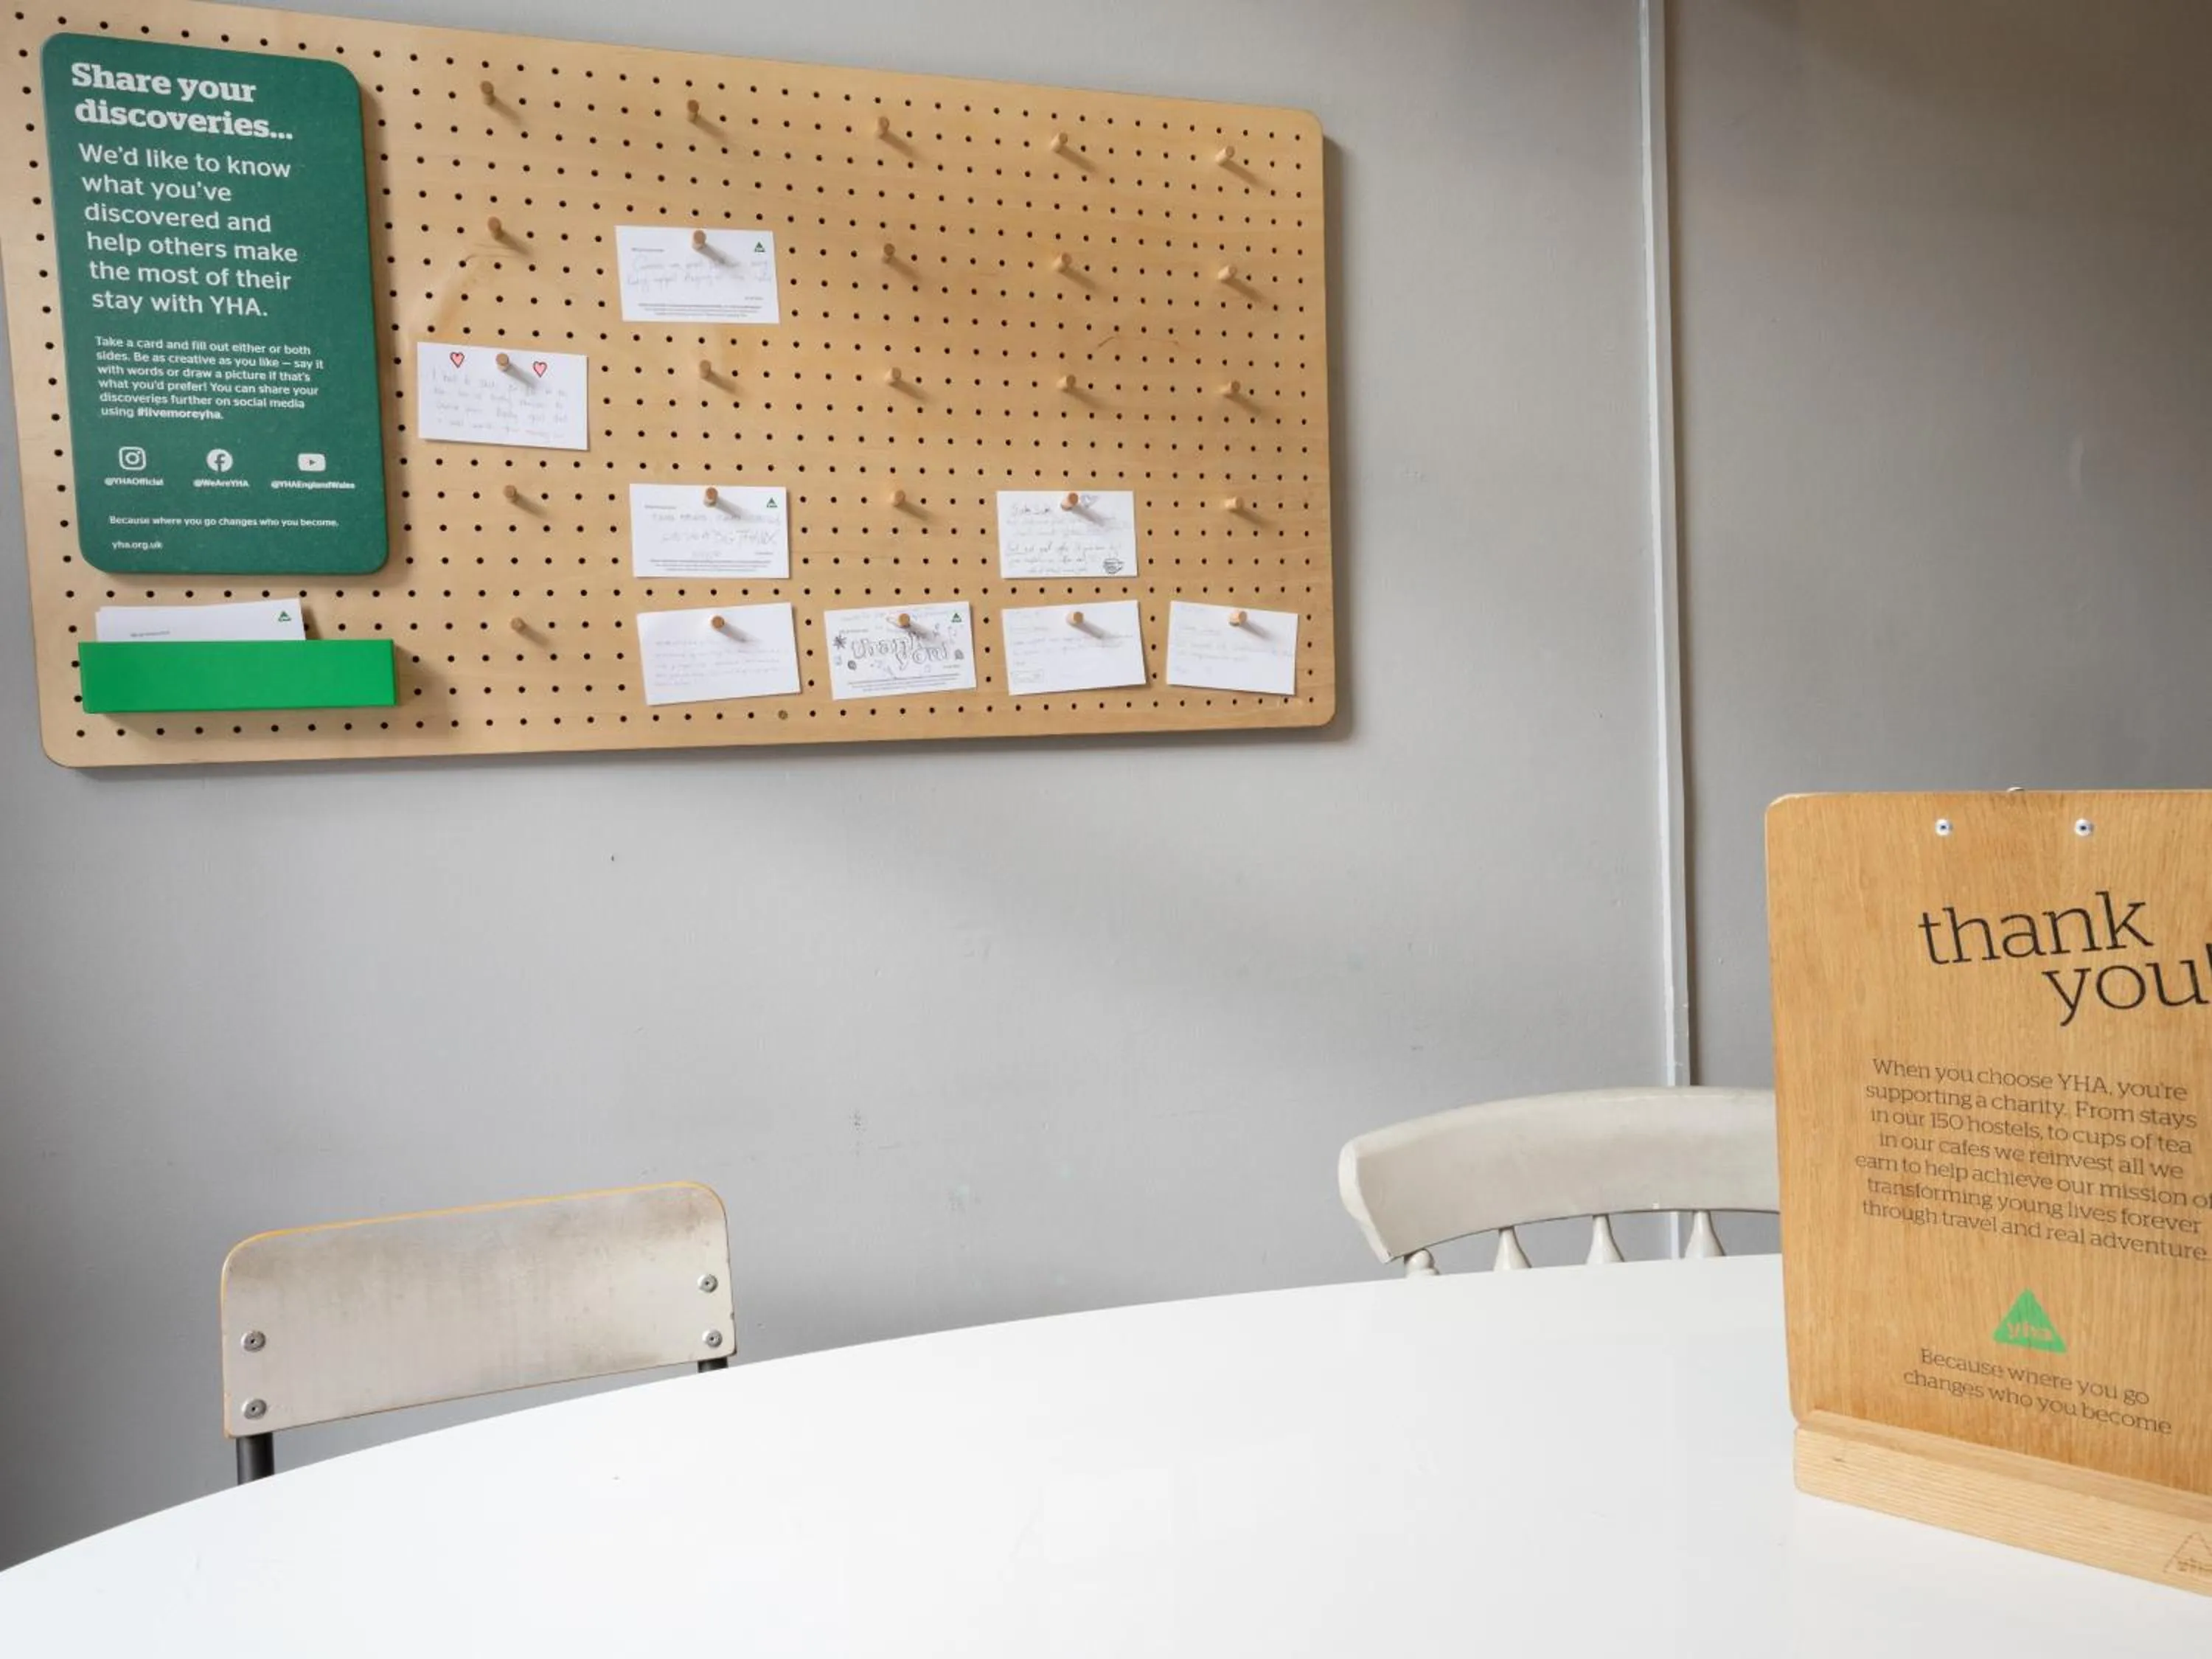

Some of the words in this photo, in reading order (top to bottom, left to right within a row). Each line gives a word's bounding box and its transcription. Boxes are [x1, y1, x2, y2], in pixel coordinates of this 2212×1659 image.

[71, 62, 173, 95] Share
[177, 77, 257, 102] your
[74, 99, 293, 140] discoveries...
[78, 142, 139, 167] We'd
[145, 148, 189, 170] like
[196, 154, 220, 173] to
[227, 156, 291, 178] know
[81, 175, 144, 196] what
[150, 181, 232, 202] you've
[83, 202, 220, 229] discovered
[227, 214, 271, 233] and
[86, 231, 142, 256] help
[147, 235, 227, 259] others
[233, 243, 298, 262] make
[88, 260, 131, 282] the
[137, 266, 198, 286] most
[205, 268, 229, 287] of
[235, 270, 291, 291] their
[91, 291, 143, 313] stay
[150, 294, 204, 314] with
[209, 296, 268, 317] YHA.
[94, 335, 124, 347] Take
[126, 339, 133, 348] a
[136, 339, 163, 349] card
[165, 340, 189, 350] and
[191, 340, 207, 351] fill
[209, 342, 229, 352] out
[232, 343, 266, 353] either
[268, 345, 282, 354] or
[284, 344, 310, 355] both
[96, 350, 131, 362] sides.
[133, 352, 150, 362] Be
[152, 355, 166, 363] as
[167, 355, 216, 365] creative
[218, 357, 232, 366] as
[234, 358, 256, 368] you
[259, 357, 279, 368] like
[293, 361, 313, 370] say
[315, 359, 324, 369] it
[97, 365, 125, 375] with
[126, 366, 164, 377] words
[166, 369, 179, 378] or
[182, 368, 212, 378] draw
[215, 370, 223, 378] a
[224, 369, 266, 380] picture
[268, 370, 277, 381] if
[279, 371, 310, 382] that's
[98, 379, 129, 389] what
[131, 380, 164, 392] you'd
[167, 381, 208, 392] prefer!
[209, 383, 232, 393] You
[234, 385, 256, 394] can
[258, 384, 290, 394] share
[293, 386, 319, 397] your
[100, 392, 168, 404] discoveries
[170, 394, 212, 406] further
[215, 397, 231, 406] on
[232, 397, 267, 408] social
[269, 399, 305, 409] media
[100, 406, 135, 419] using
[109, 515, 150, 525] Because
[152, 516, 182, 526] where
[184, 518, 202, 527] you
[204, 518, 218, 527] go
[218, 517, 257, 528] changes
[258, 518, 279, 526] who
[279, 519, 299, 528] you
[300, 518, 339, 527] become.
[111, 540, 163, 551] yha.org.uk
[1918, 889, 2154, 966] thank
[1872, 1057, 1930, 1079] When
[1934, 1064, 1973, 1085] you
[1977, 1067, 2054, 1090] choose
[2117, 1080, 2188, 1102] you're
[1864, 1082, 1972, 1110] supporting
[1975, 1094, 1987, 1108] a
[2075, 1099, 2135, 1124] From
[2138, 1107, 2198, 1130] stays
[1871, 1106, 1891, 1124] in
[1892, 1111, 1925, 1127] our
[1930, 1110, 1964, 1131] 150
[1966, 1116, 2045, 1142] hostels,
[2047, 1124, 2069, 1141] to
[2072, 1130, 2126, 1150] cups
[2129, 1133, 2154, 1152] of
[2157, 1138, 2194, 1155] tea
[1878, 1132, 1899, 1149] in
[1900, 1136, 1935, 1154] our
[1938, 1138, 1991, 1159] cafes
[1994, 1145, 2025, 1163] we
[2028, 1148, 2114, 1172] reinvest
[2118, 1157, 2144, 1176] all
[2149, 1162, 2184, 1180] we
[1854, 1153, 1899, 1172] earn
[1902, 1156, 1921, 1174] to
[1924, 1159, 1969, 1182] help
[1971, 1166, 2053, 1191] achieve
[2056, 1177, 2094, 1196] our
[2099, 1183, 2188, 1207] mission
[1862, 1199, 1937, 1225] through
[1941, 1210, 1997, 1234] travel
[2000, 1220, 2042, 1240] and
[2045, 1225, 2084, 1245] real
[1867, 1178, 1993, 1209] transforming
[1996, 1196, 2064, 1220] young
[2067, 1200, 2117, 1224] lives
[2121, 1207, 2203, 1234] forever
[1920, 1347, 2004, 1379] Because
[2006, 1365, 2073, 1391] where
[2076, 1378, 2118, 1401] you
[2122, 1388, 2150, 1406] go
[1902, 1368, 1985, 1398] changes
[1986, 1385, 2034, 1408] who
[2035, 1394, 2078, 1418] you
[2081, 1402, 2173, 1435] become
